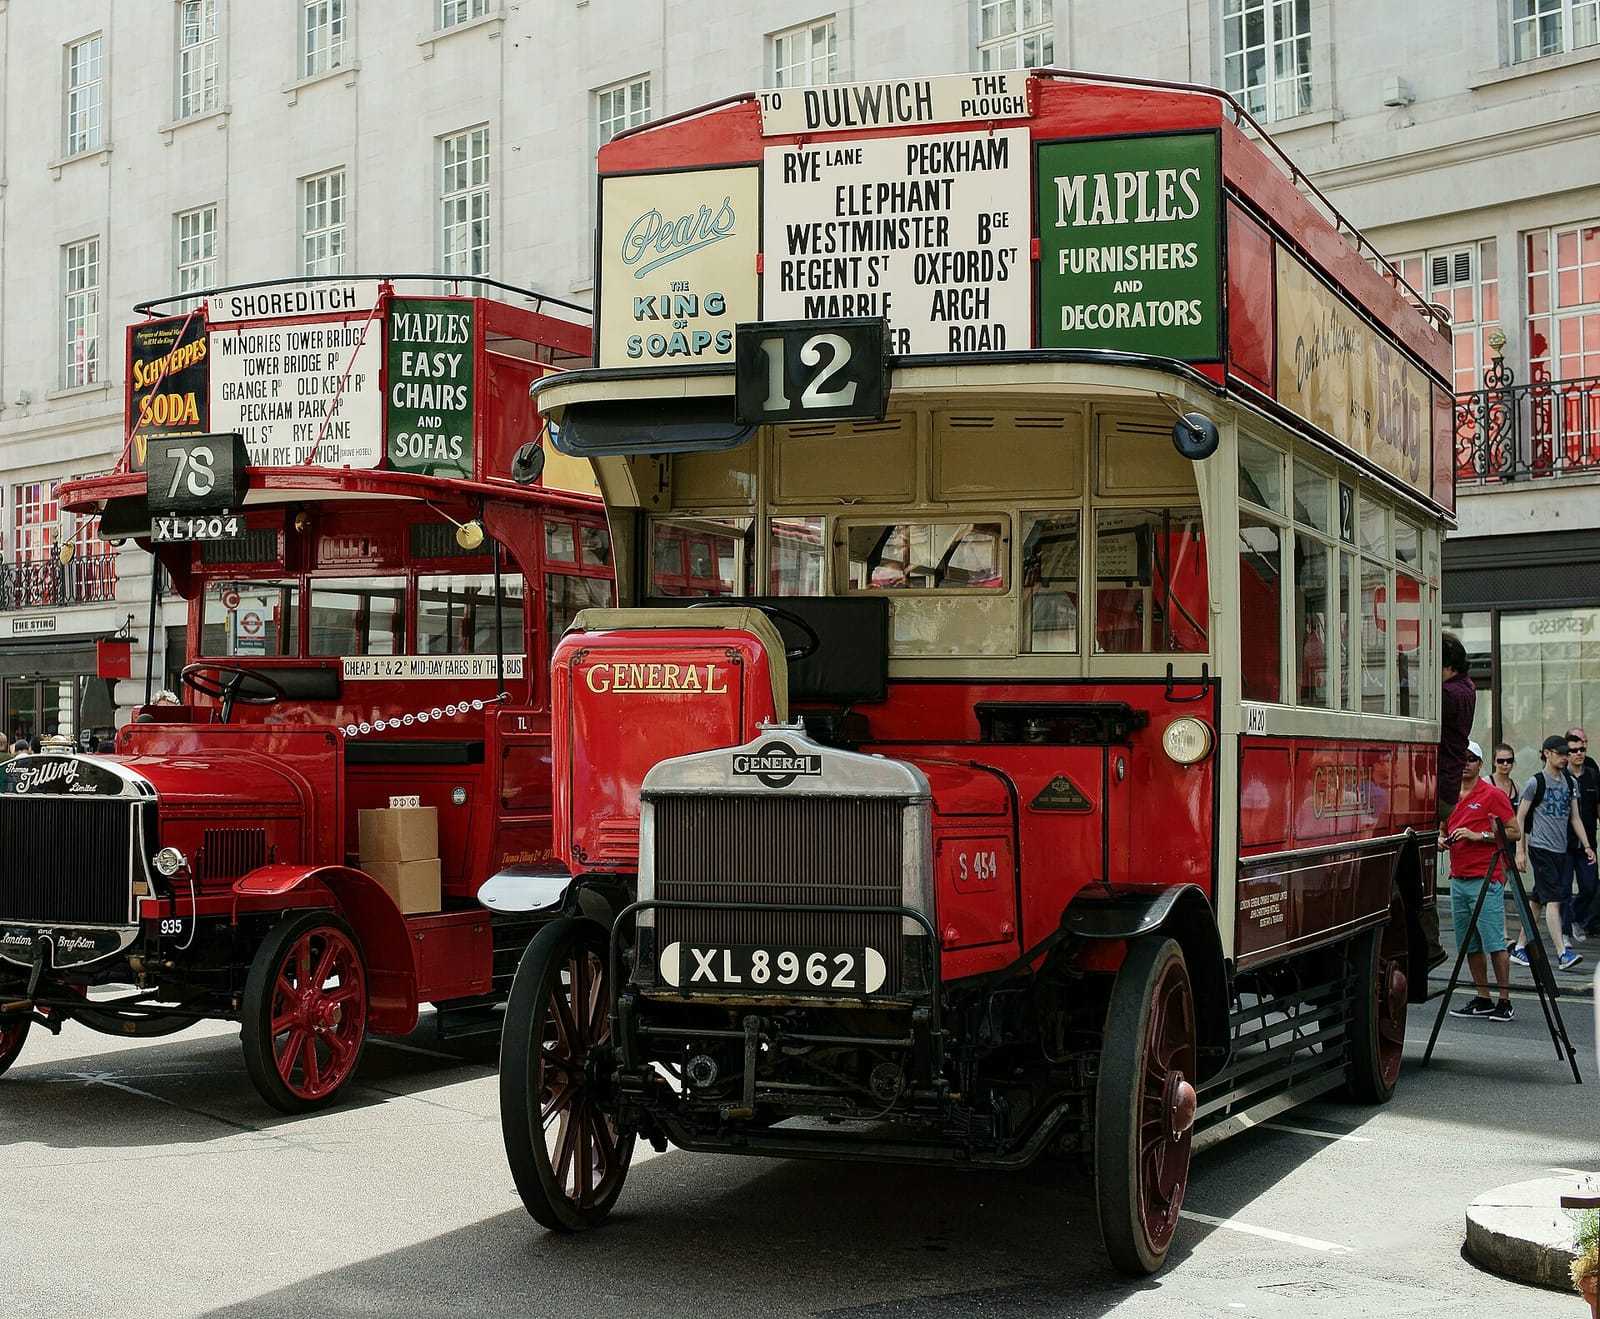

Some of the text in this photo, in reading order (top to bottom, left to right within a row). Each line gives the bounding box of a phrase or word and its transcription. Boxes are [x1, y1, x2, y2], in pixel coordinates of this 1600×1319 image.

[972, 76, 1008, 96] THE
[761, 81, 933, 129] TO DULWICH
[961, 96, 1025, 118] PLOUGH
[783, 137, 1009, 184] RYE LANE PECKHAM
[835, 178, 955, 217] ELEPHANT
[1053, 167, 1201, 227] MAPLES
[620, 196, 737, 268] Pears
[786, 215, 949, 256] WESTMINSTER
[780, 256, 865, 292] REGENT
[914, 249, 994, 286] OXFORD
[1059, 242, 1199, 275] FURNISHERS
[670, 281, 689, 292] THE
[1113, 280, 1143, 293] AND
[213, 287, 356, 317] TO SHOREDITCH
[633, 292, 727, 321] KING
[930, 288, 990, 322] ARCH
[1061, 299, 1202, 331] DECORATORS
[392, 312, 470, 344] MAPLES
[672, 319, 688, 330] OF
[949, 324, 1006, 353] ROAD
[222, 333, 281, 356] MINORIES
[286, 331, 323, 351] TOWER
[327, 327, 366, 349] BRIDGE
[627, 330, 733, 359] SOAPS
[133, 337, 207, 391] SCHWEPPES
[243, 357, 279, 377] TOWER
[284, 353, 321, 375] BRIDGE
[401, 351, 463, 378] EASY
[760, 333, 858, 412] 12
[222, 380, 268, 401] GRANGE
[297, 377, 319, 396] OLD
[322, 375, 352, 395] KENT
[392, 382, 468, 411] CHAIRS
[139, 392, 200, 427] SODA
[240, 401, 293, 422] PECKHAM
[298, 399, 327, 419] PARK
[417, 415, 442, 429] AND
[293, 423, 314, 442] RYE
[319, 421, 351, 441] LANE
[395, 432, 463, 460] SOFAS
[273, 447, 291, 466] RYE
[295, 444, 340, 465] DULWICH
[14, 621, 29, 630] THE
[344, 661, 371, 676] CHEAP
[410, 660, 444, 675] MID-DAY
[444, 660, 469, 675] FARES
[472, 660, 483, 675] BY
[507, 659, 522, 675] BUS
[585, 663, 728, 695] GENERAL
[517, 716, 527, 730] TL
[16, 759, 80, 793] Tilling
[69, 782, 98, 792] Limited
[733, 756, 821, 776] GENERAL
[1313, 765, 1375, 820] GENERAL
[958, 851, 997, 881] S 454
[160, 919, 182, 935] 935
